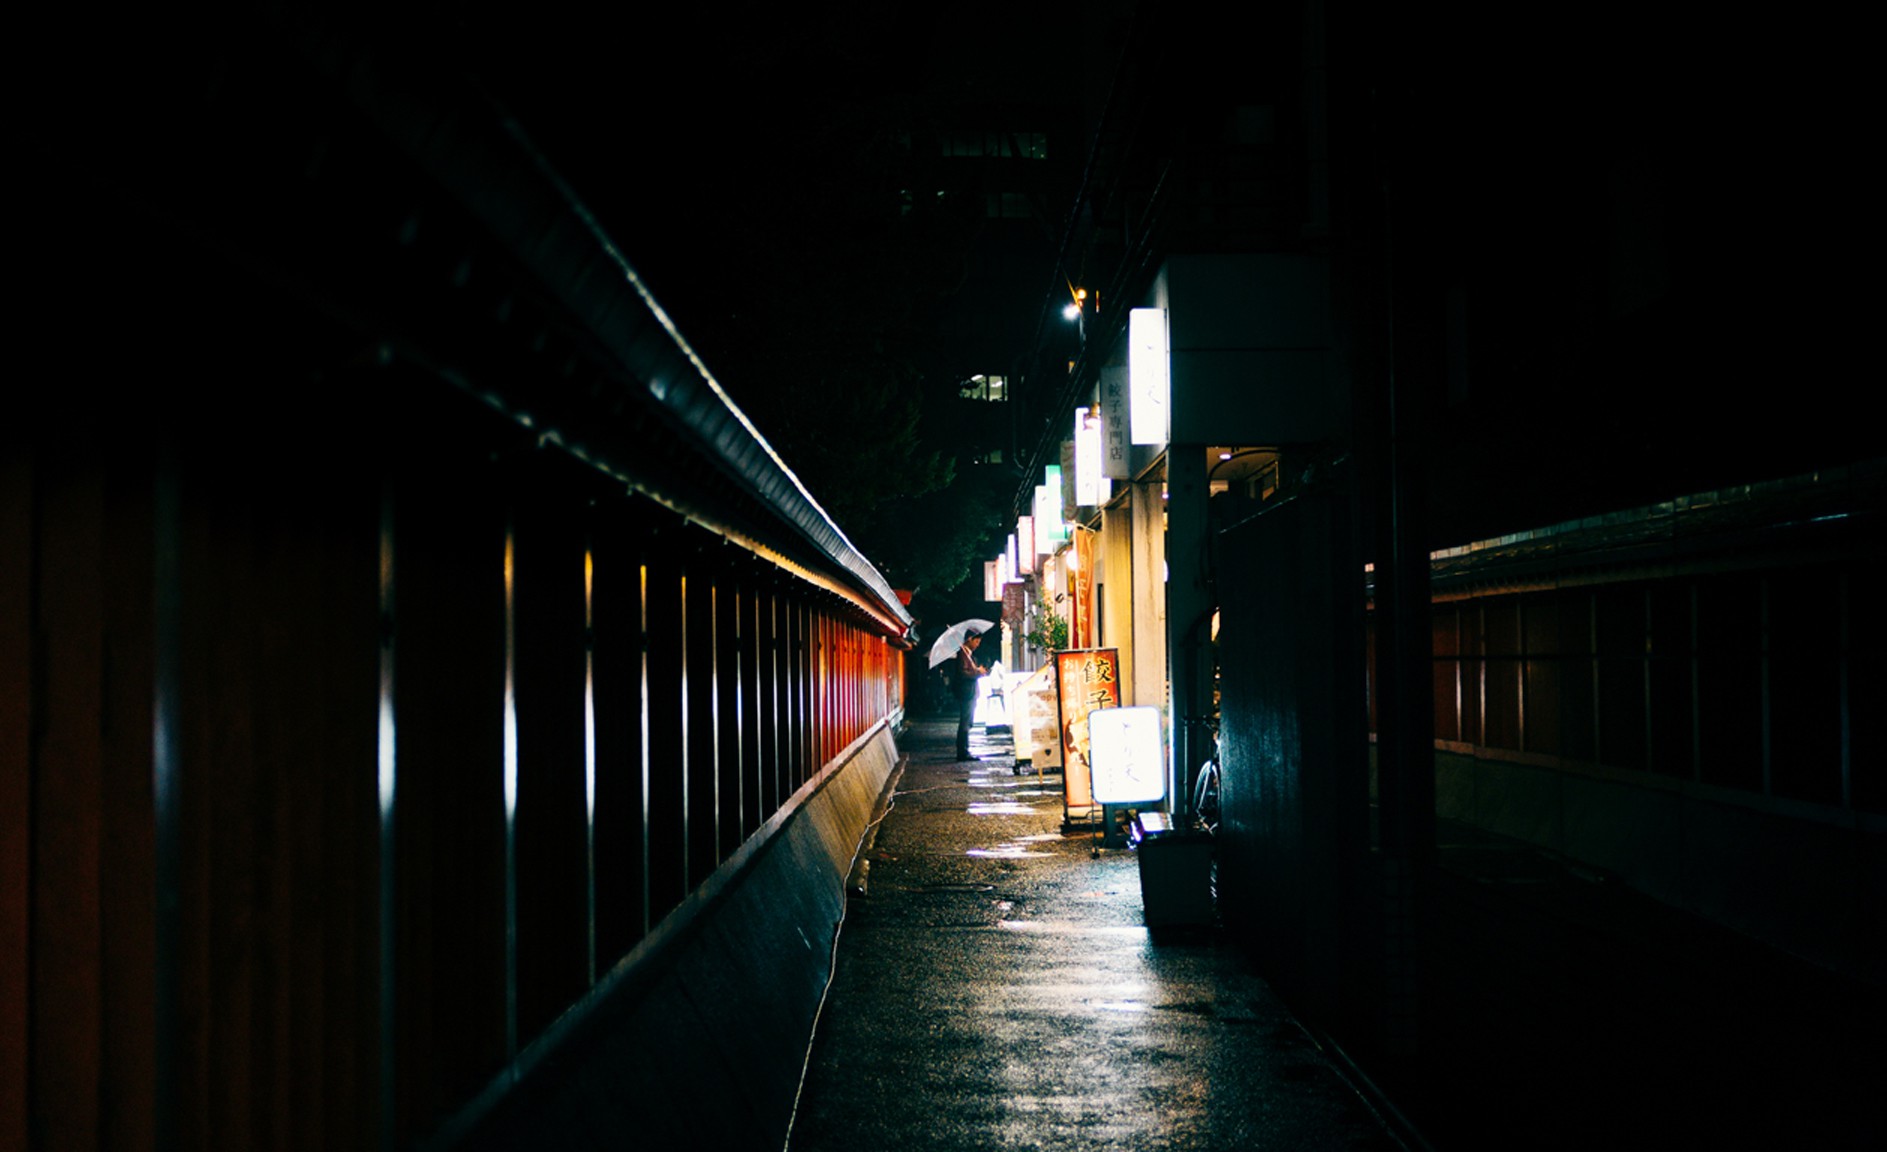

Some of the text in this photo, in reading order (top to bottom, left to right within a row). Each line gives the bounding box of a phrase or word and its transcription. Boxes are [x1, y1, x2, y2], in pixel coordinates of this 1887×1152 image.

[1108, 383, 1123, 460] 餃子専門店
[1084, 660, 1112, 709] 餃子
